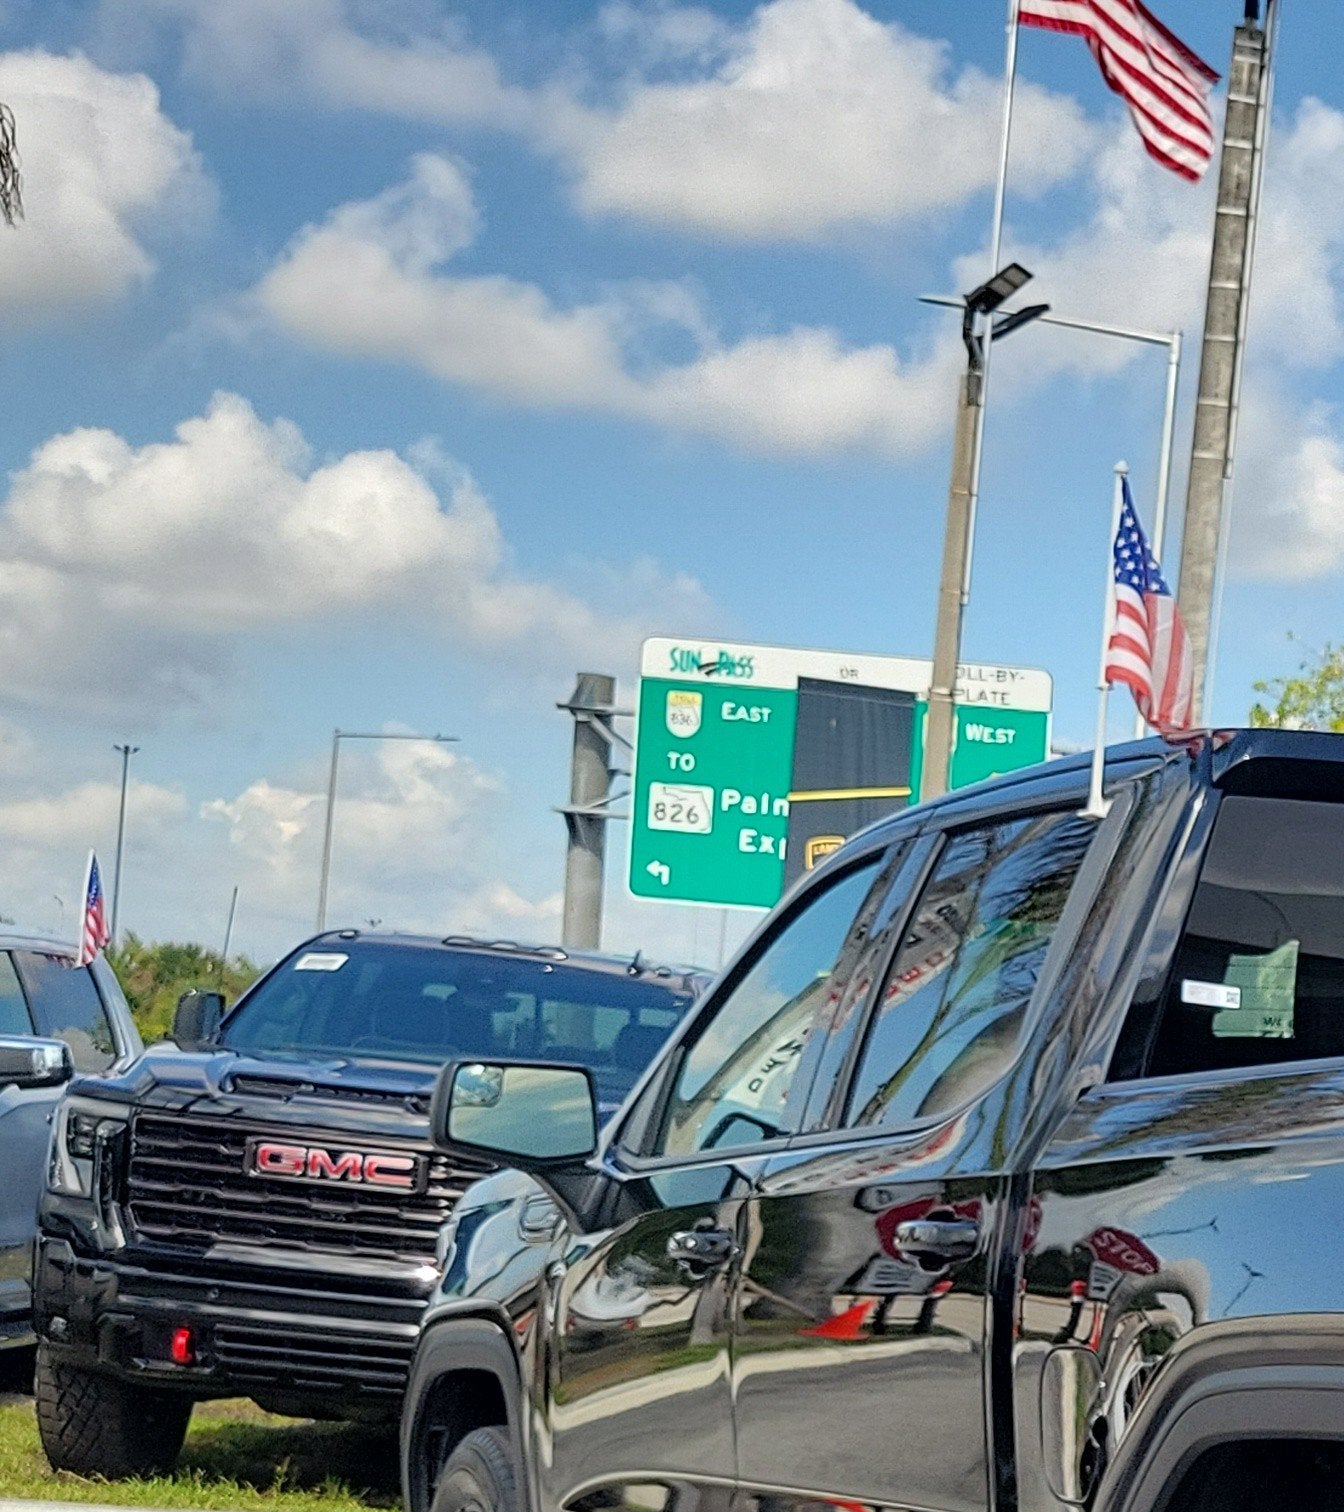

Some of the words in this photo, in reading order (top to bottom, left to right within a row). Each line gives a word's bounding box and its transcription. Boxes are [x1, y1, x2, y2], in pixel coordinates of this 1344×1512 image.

[955, 666, 1025, 683] OLL-BY-
[721, 701, 773, 723] EAST
[965, 723, 1017, 745] WEST
[667, 751, 696, 772] TO
[653, 802, 700, 825] 826
[257, 1142, 415, 1188] GMC
